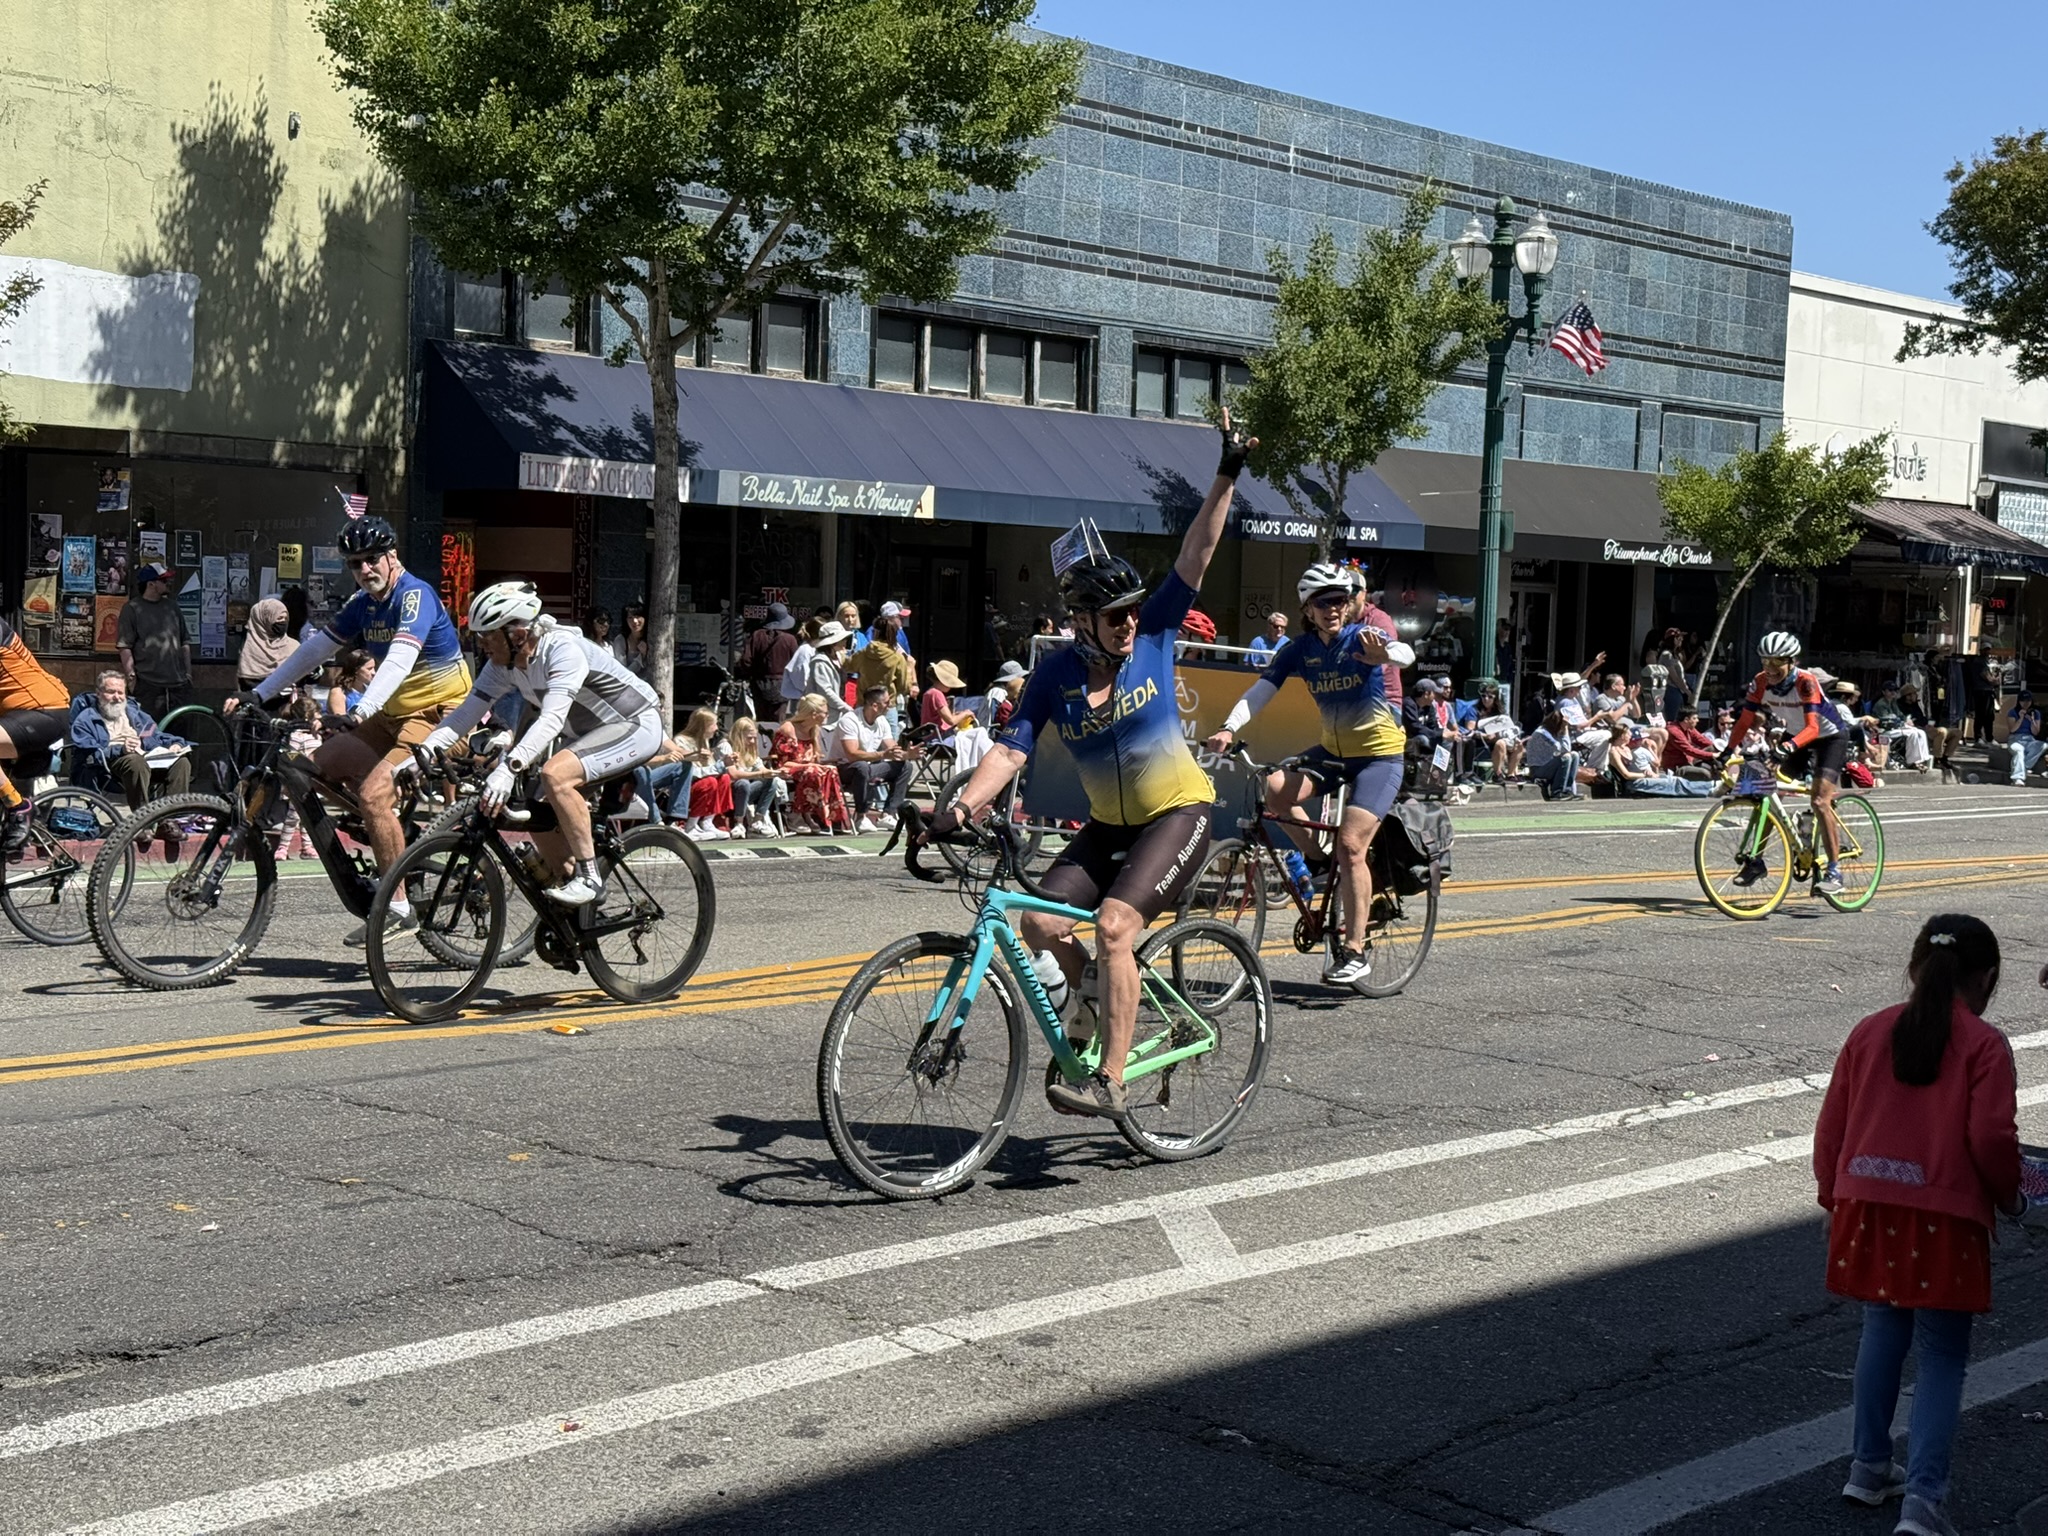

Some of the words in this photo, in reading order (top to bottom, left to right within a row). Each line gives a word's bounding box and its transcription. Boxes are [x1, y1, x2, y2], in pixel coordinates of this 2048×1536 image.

[526, 460, 579, 490] LITTLE
[742, 475, 785, 504] Bella
[786, 479, 823, 507] Nail
[824, 485, 850, 511] Spa
[853, 485, 866, 510] &
[867, 486, 914, 516] Waxing
[1241, 519, 1281, 536] TOMO'S
[1335, 525, 1356, 540] NAIL
[1360, 527, 1378, 541] SPA
[1604, 538, 1659, 563] Triumphant
[1659, 544, 1678, 567] Life
[1679, 546, 1713, 565] Church
[762, 587, 789, 604] TK
[1417, 662, 1452, 673] Wednesday
[1154, 864, 1180, 896] Team
[1177, 815, 1208, 867] Alameda
[1006, 938, 1061, 1029] SPECIALIZED
